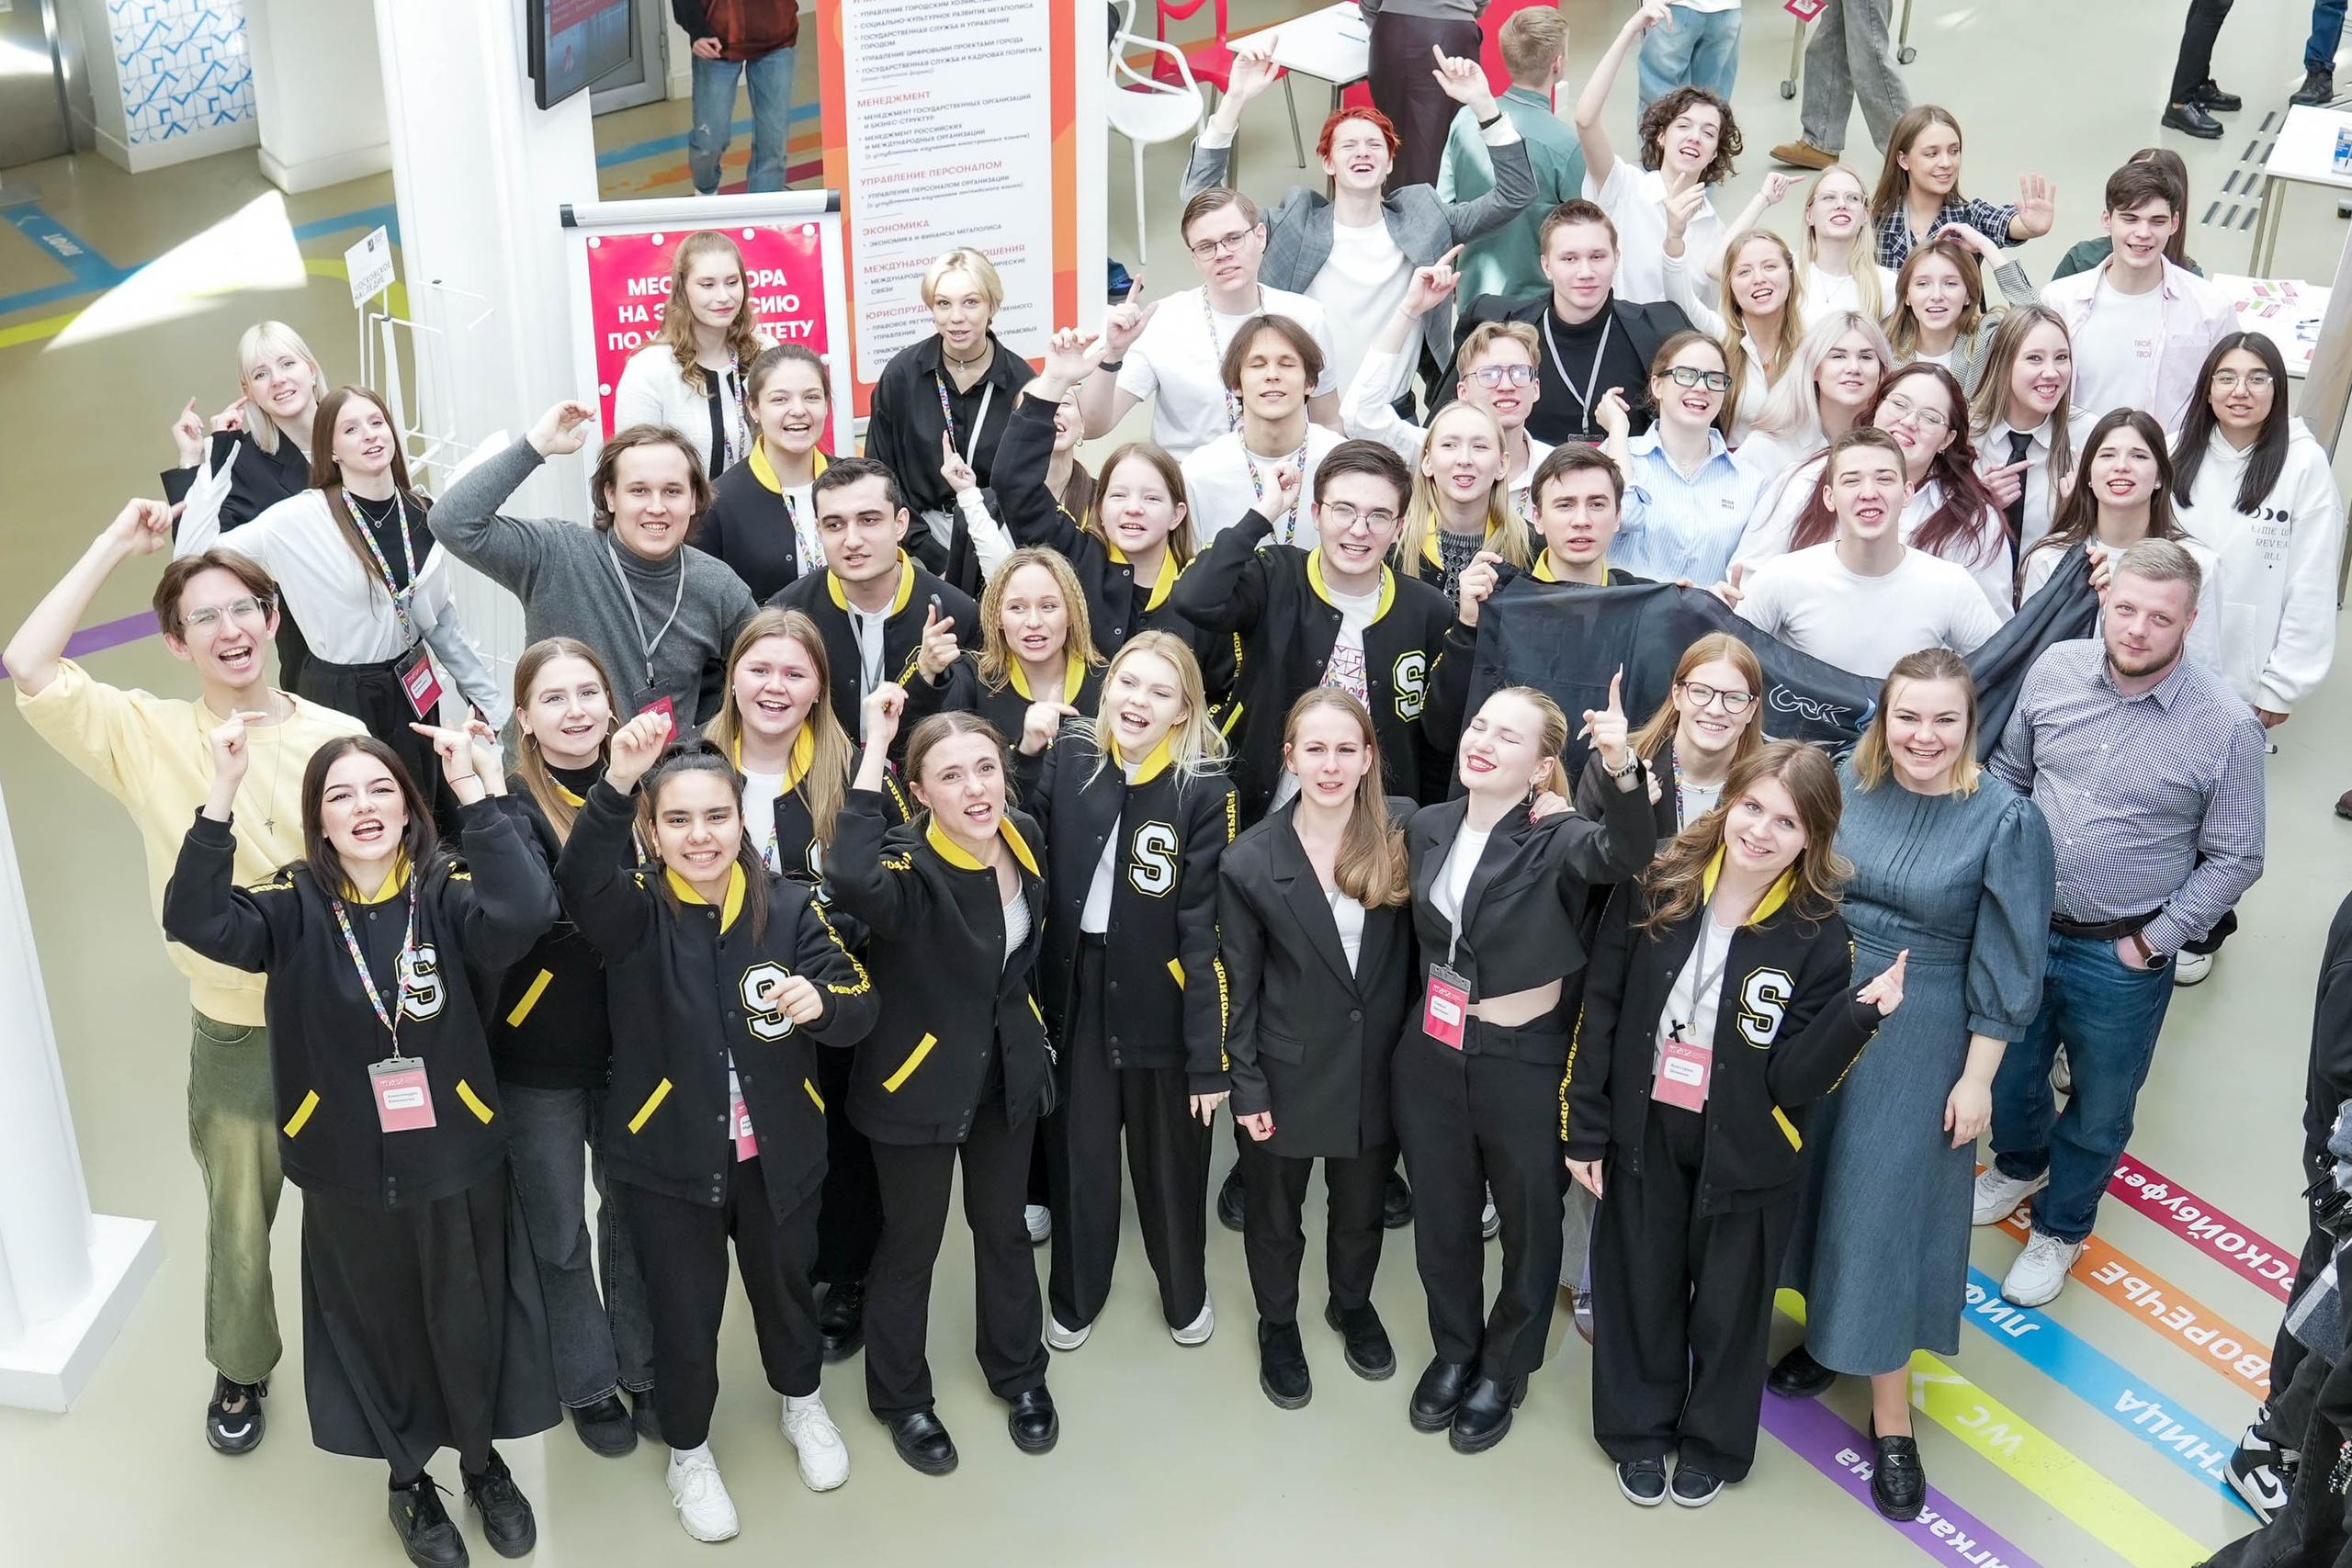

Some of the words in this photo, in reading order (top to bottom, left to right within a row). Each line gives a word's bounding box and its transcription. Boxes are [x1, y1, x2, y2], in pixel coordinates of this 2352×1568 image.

[860, 6, 903, 17] УПРАВЛЕНИЕ
[860, 13, 950, 29] СОЦИАЛЬНО-КУЛЬТУРНОЕ
[952, 7, 986, 18] РАЗВИТИЕ
[988, 3, 1034, 13] МЕГАПОЛИСА
[860, 27, 928, 41] ГОСУДАРСТВЕННАЯ
[929, 24, 959, 33] СЛУЖБА
[967, 17, 1011, 28] УПРАВЛЕНИЕ
[860, 40, 896, 51] ГОРОДОМ
[862, 51, 905, 62] УПРАВЛЕНИЕ
[906, 45, 952, 56] ЦИФРОВЫМИ
[954, 40, 995, 51] ПРОЕКТАМИ
[996, 37, 1023, 46] ГОРОДА
[862, 61, 929, 74] ГОСУДАРСТВЕННАЯ
[930, 56, 960, 66] СЛУЖБА
[967, 51, 1004, 61] КАДРОВАЯ
[1005, 46, 1043, 56] ПОЛИТИКА
[857, 91, 931, 108] МЕНЕДЖМЕНТ
[864, 108, 911, 121] МЕНЕДЖМЕНТ
[913, 100, 981, 115] ГОСУДАРСТВЕННЫХ
[982, 94, 1031, 106] ОРГАНИЗАЦИЙ
[865, 130, 912, 141] МЕНЕДЖМЕНТ
[914, 123, 963, 134] РОССИЙСКИХ
[870, 115, 935, 129] БИЗНЕС-СТРУКТУР
[871, 136, 935, 150] МЕЖДУНАРОДНЫХ
[936, 129, 986, 141] ОРГАНИЗАЦИЙ
[860, 171, 926, 187] УПРАВЛЕНИЕ
[929, 161, 1002, 177] ПЕРСОНАЛОМ
[867, 188, 910, 199] УПРАВЛЕНИЕ
[911, 182, 960, 193] ПЕРСОНАЛОМ
[862, 220, 930, 236] ЭКОНОМИКА
[869, 236, 913, 247] ЭКОНОМИКА
[921, 231, 956, 240] ФИНАНСЫ
[956, 224, 1001, 235] МЕГАПОЛИСА
[864, 257, 937, 274] МЕЖДУНАРОД
[982, 244, 1025, 257] ОШЕНИЯ
[628, 276, 672, 296] МЕС
[748, 269, 786, 288] ОРА
[871, 273, 925, 285] МЕЖДУНАРОДН
[871, 287, 894, 295] СВЯЗИ
[618, 305, 649, 323] НА
[865, 306, 930, 320] ЮРИСПРУДЕ
[873, 321, 907, 331] ПРАВОВОЕ
[873, 330, 916, 341] УПРАВЛЕНИЯ
[608, 332, 642, 351] ПО
[2256, 538, 2289, 549] REVEA
[1392, 649, 1426, 723] S
[1128, 820, 1179, 897] S
[394, 942, 447, 1022] S
[1736, 966, 1796, 1049] S
[1965, 1282, 2041, 1338] ЛИФ
[2090, 1261, 2271, 1387] ВОРЕЧЬЕ
[1956, 1405, 2024, 1455] WC
[2114, 1389, 2227, 1483] ТНИЦА
